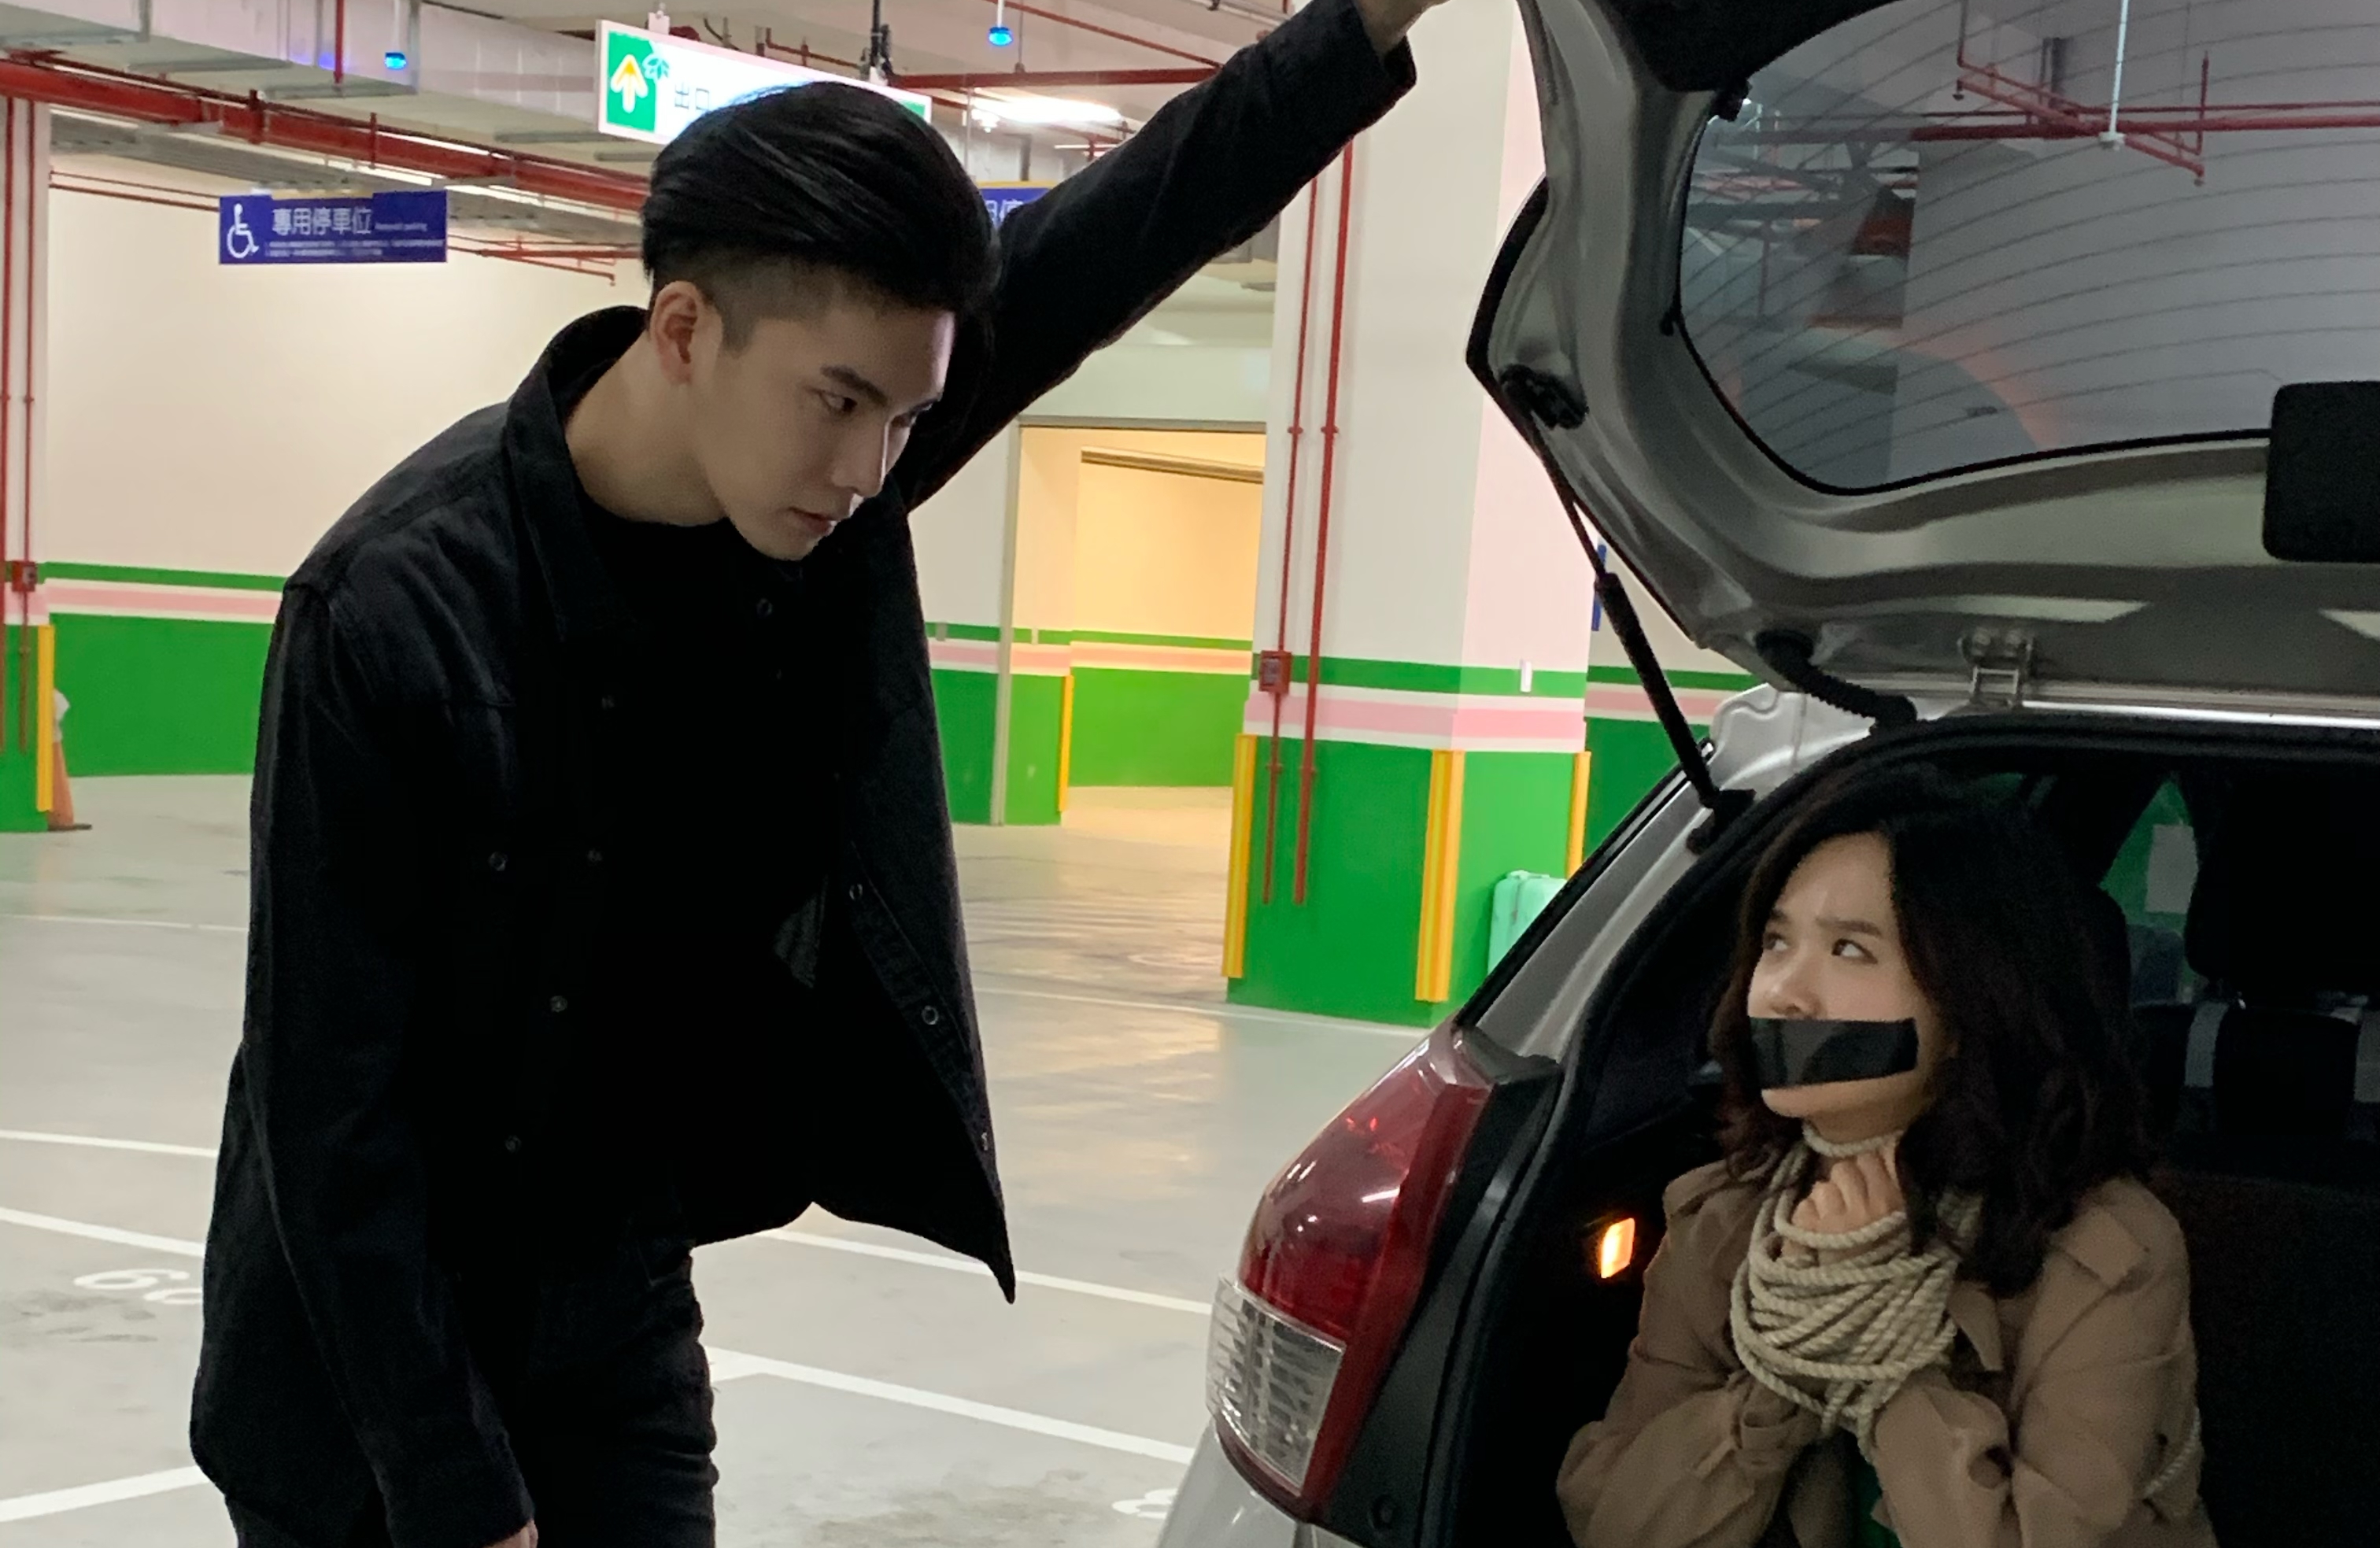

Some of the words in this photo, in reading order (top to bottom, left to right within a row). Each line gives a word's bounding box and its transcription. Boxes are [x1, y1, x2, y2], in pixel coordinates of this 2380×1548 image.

[674, 82, 710, 110] 出口
[272, 206, 372, 235] 專用停車位
